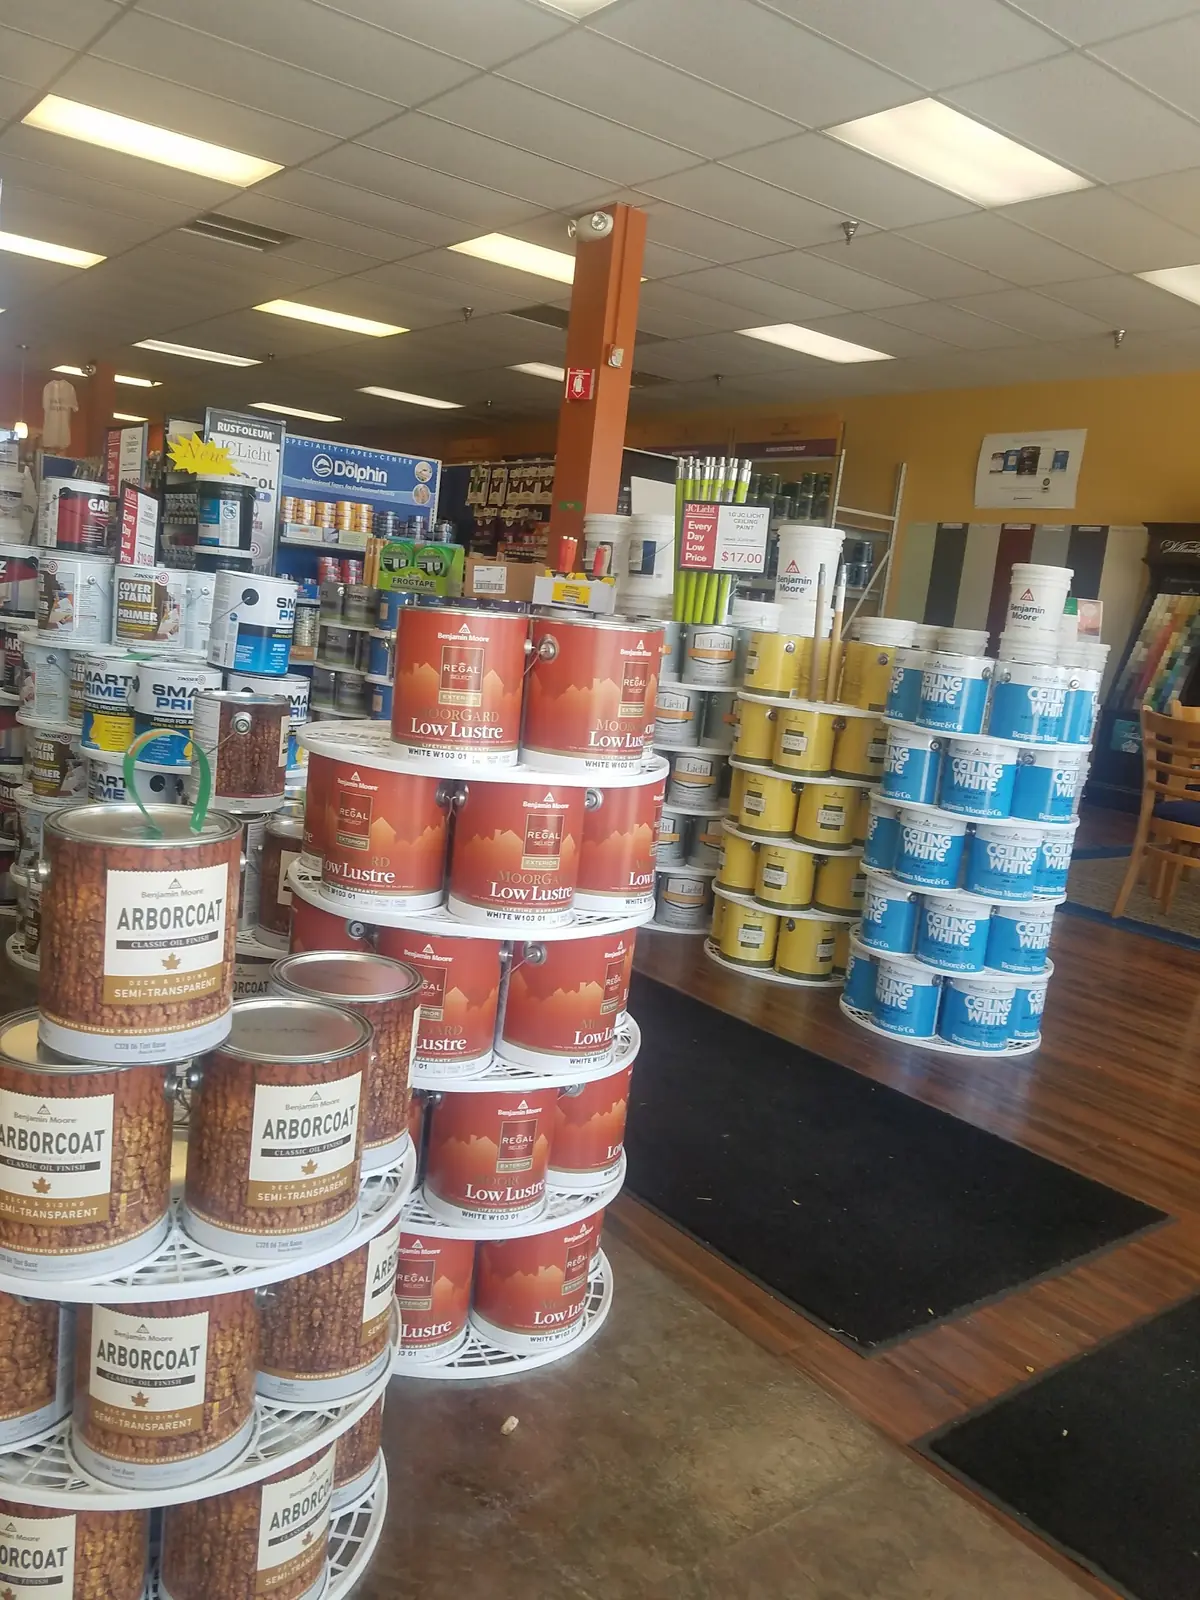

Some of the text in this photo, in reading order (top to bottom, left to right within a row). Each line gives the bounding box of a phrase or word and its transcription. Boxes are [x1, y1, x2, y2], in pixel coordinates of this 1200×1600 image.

[217, 421, 273, 440] RUST-OLEUM
[184, 442, 225, 464] New
[285, 437, 413, 465] SPECIALTY TAPES CENTER
[334, 460, 388, 483] Dolphin
[124, 510, 136, 525] Every
[688, 521, 712, 532] Every
[687, 531, 705, 542] Day
[686, 541, 705, 551] Low
[685, 552, 707, 562] Price
[721, 551, 762, 563] $17.00
[392, 577, 435, 588] FROGTAPE
[777, 575, 812, 585] Benjamin
[119, 582, 152, 593] COVER
[780, 584, 806, 593] Moore
[119, 591, 152, 603] STAIN
[118, 609, 158, 621] PRIMER
[1010, 603, 1046, 615] Benjamin
[1012, 611, 1037, 622] Moore
[437, 632, 490, 642] Benjamin Moore
[443, 663, 481, 674] REGAL
[623, 677, 647, 687] REGAL
[663, 696, 686, 709] Licht
[411, 717, 503, 739] Low Lustre
[588, 731, 623, 748] Low
[408, 748, 431, 757] WHITE
[433, 751, 455, 759] W103
[585, 760, 609, 768] WHITE
[685, 761, 710, 774] Licht
[951, 758, 1004, 779] CEILING
[358, 783, 379, 791] Moore
[953, 771, 999, 792] WHITE
[523, 800, 552, 809] Benjamin
[339, 808, 369, 820] REGAL
[527, 831, 561, 840] REGAL
[903, 827, 952, 850] CEILING
[903, 840, 947, 862] WHITE
[986, 842, 1037, 862] CEILING
[989, 856, 1034, 875] WHITE
[343, 862, 396, 883] Lustre
[141, 888, 204, 899] Benjamin Moore
[490, 881, 573, 902] Low Lustre
[680, 882, 703, 894] Licht
[116, 898, 223, 931] ARBORCOAT
[486, 911, 512, 920] WHITE
[514, 913, 535, 922] W103
[926, 911, 977, 934] CEILING
[131, 935, 210, 949] CLASSIC OIL FINISH
[928, 924, 972, 947] WHITE
[403, 949, 454, 962] Benjamin Moore
[128, 979, 156, 987] DECK
[176, 972, 208, 983] SIDING
[114, 977, 216, 998] SEMI-TRANSPARENT
[964, 995, 1013, 1013] CEILING
[967, 1008, 1009, 1026] WHITE
[574, 1028, 604, 1045] Low
[569, 1057, 592, 1065] WHITE
[285, 1098, 340, 1112] Benjamin Moore
[13, 1111, 77, 1124] Benjamin Moore
[497, 1108, 525, 1117] Benjamin
[262, 1104, 357, 1140] ARBORCOAT
[501, 1135, 534, 1145] REGAL
[274, 1139, 344, 1157] CLASSIC OIL FINISH
[6, 1158, 87, 1172] CLASSIC OIL FINISH
[257, 1176, 348, 1201] SEMI-TRANSPARENT
[271, 1183, 296, 1191] DECK
[466, 1183, 504, 1202] Low
[505, 1179, 546, 1201] Lustre
[46, 1200, 85, 1208] SIDING
[461, 1211, 488, 1221] WHITE
[489, 1213, 509, 1221] W103
[420, 1248, 441, 1256] Moore
[567, 1254, 588, 1268] REGAL
[397, 1274, 431, 1283] REGAL
[534, 1307, 567, 1325] Low
[114, 1329, 147, 1342] Benjamin
[401, 1320, 452, 1338] Lustre
[96, 1338, 201, 1371] ARBORCOAT
[106, 1372, 182, 1386] CLASSIC OIL FINISH
[94, 1410, 193, 1431] SEMI-TRANSPARENT
[143, 1413, 181, 1421] SIDING
[16, 1533, 41, 1542] Moore
